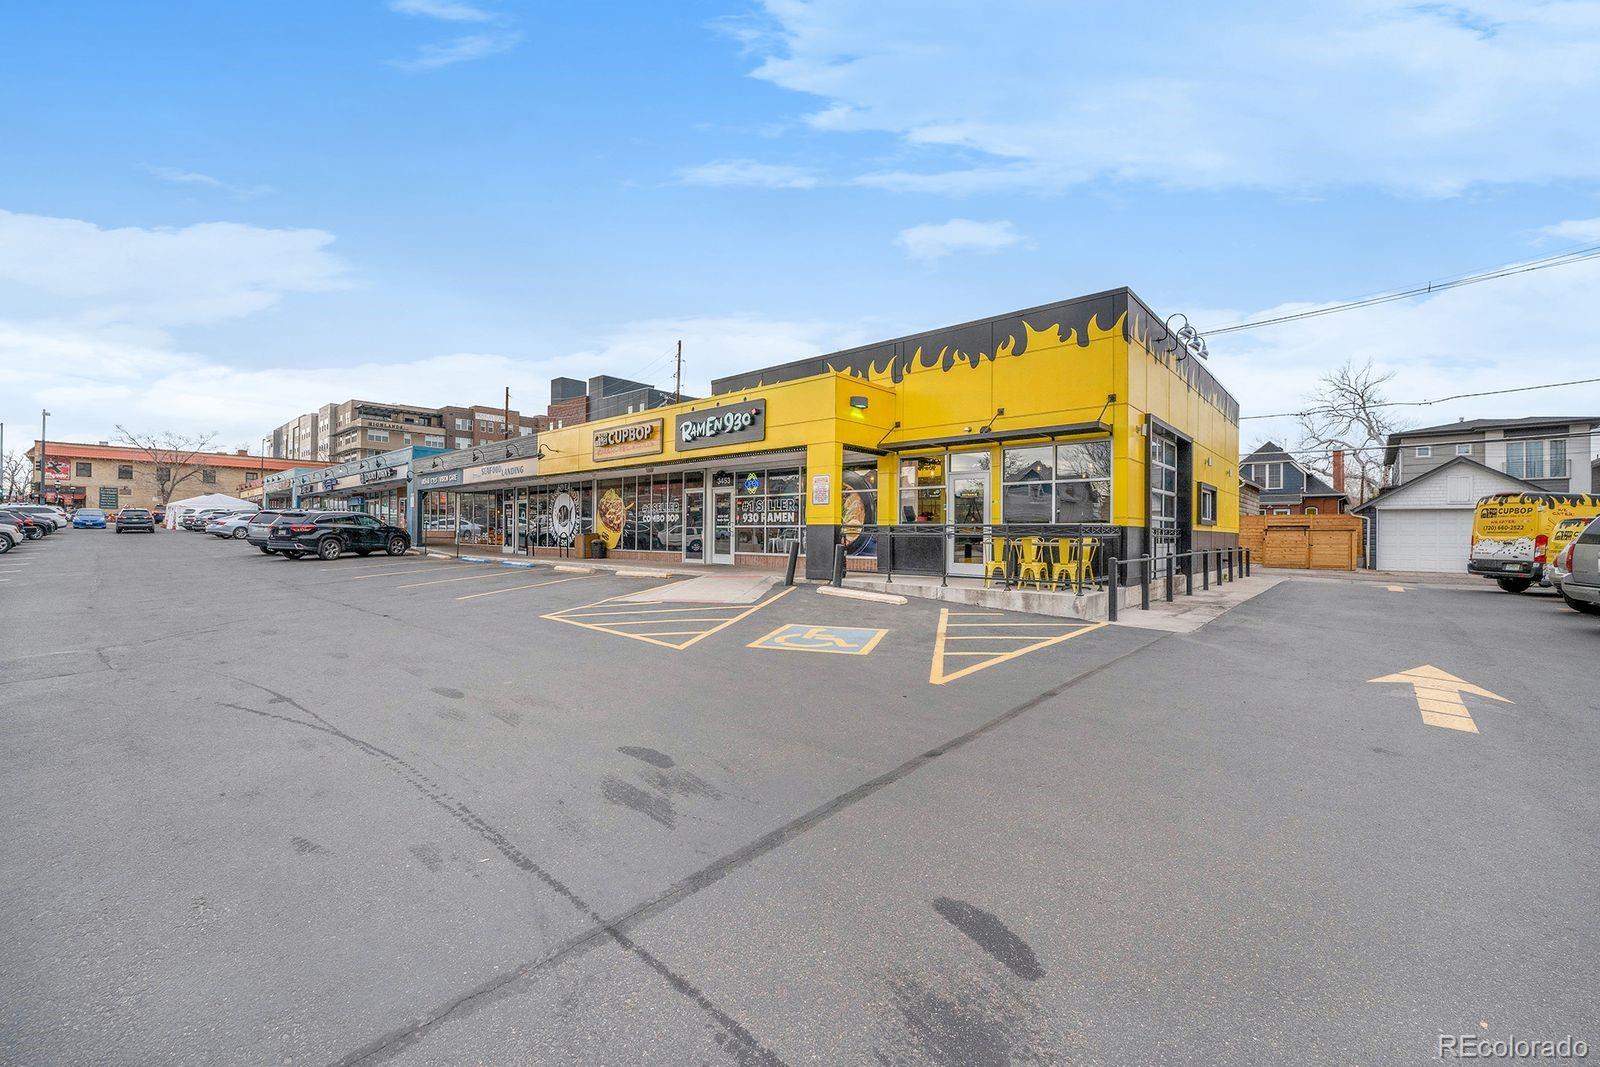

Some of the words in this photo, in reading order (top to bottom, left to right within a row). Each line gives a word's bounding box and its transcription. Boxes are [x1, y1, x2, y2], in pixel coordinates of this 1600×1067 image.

[368, 422, 403, 430] HIGHLANDS
[680, 416, 722, 442] RAMEN
[723, 412, 751, 433] 930
[608, 424, 652, 445] CUPBOP
[481, 465, 501, 475] SEAFOOD
[501, 465, 524, 476] LANDING
[742, 500, 754, 513] #1
[1498, 507, 1533, 515] CUPBOP
[743, 513, 759, 523] 930
